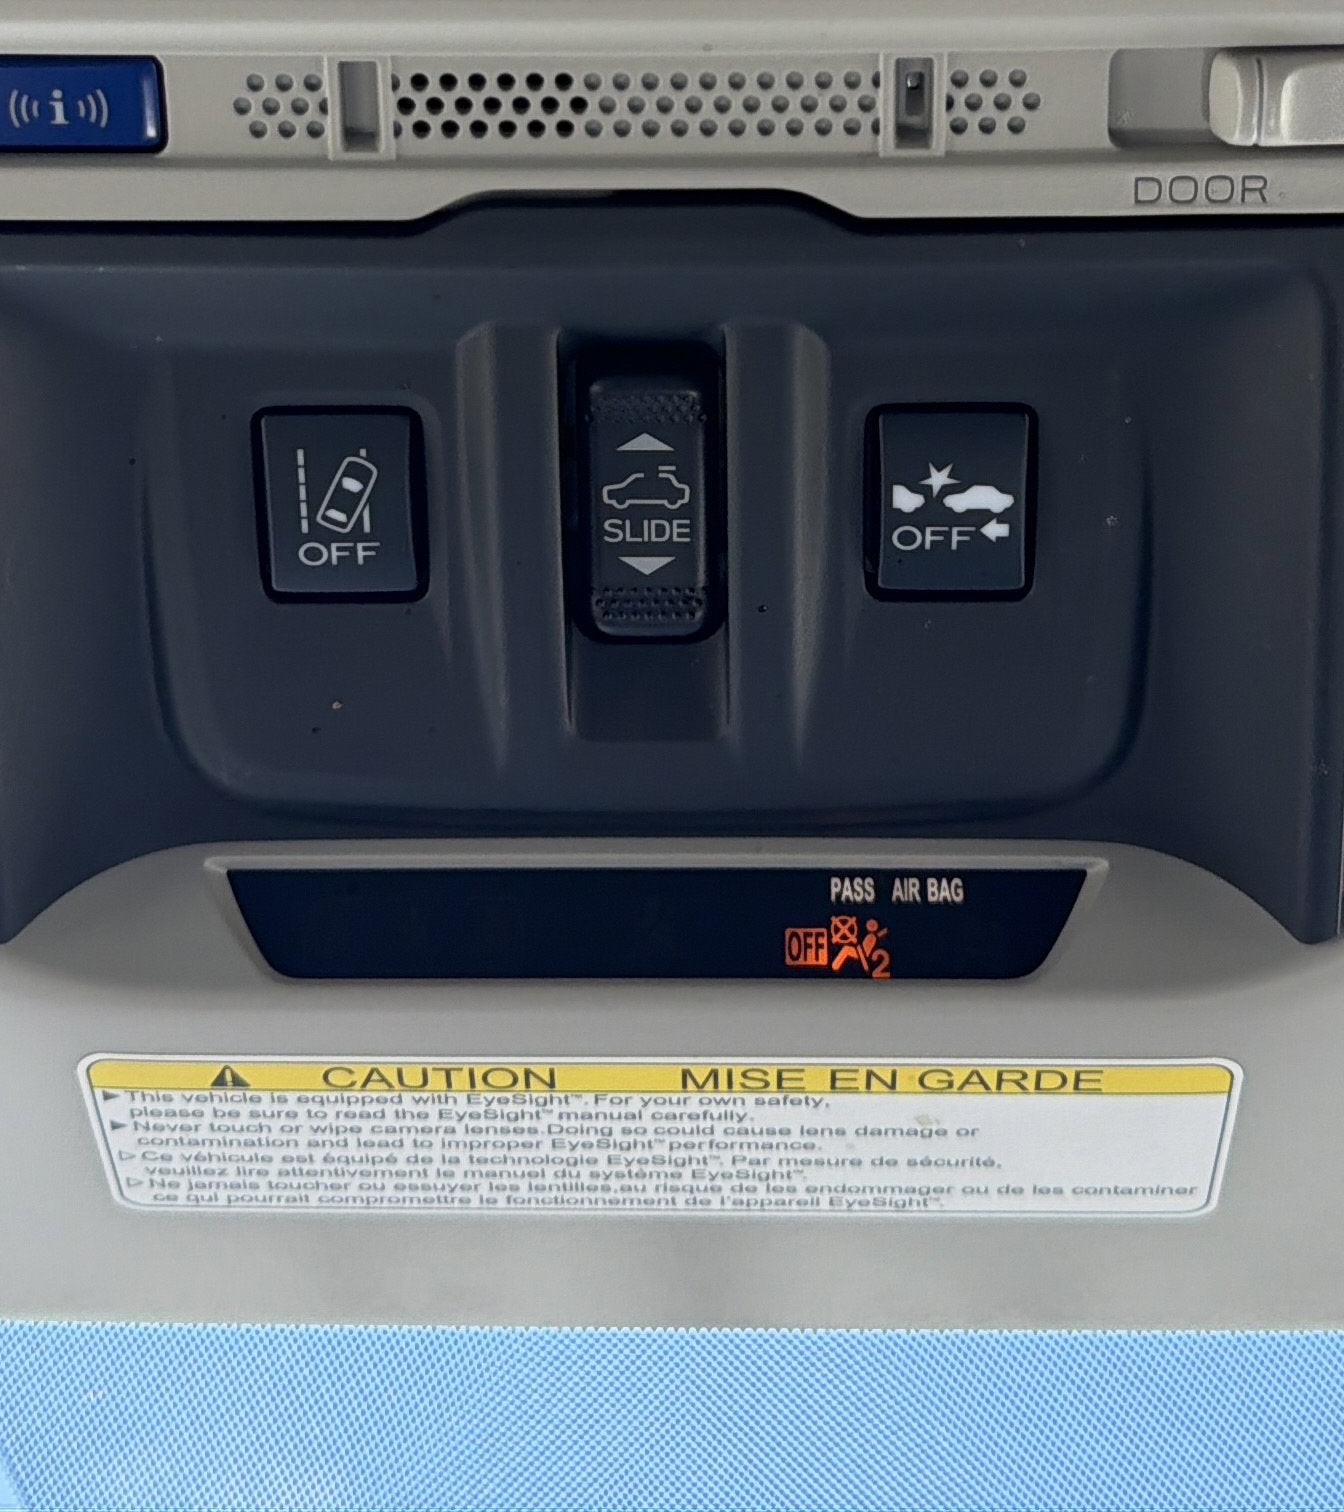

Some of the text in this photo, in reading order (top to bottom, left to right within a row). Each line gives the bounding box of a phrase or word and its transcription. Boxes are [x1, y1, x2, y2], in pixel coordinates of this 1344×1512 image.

[1133, 175, 1269, 205] DOOR
[603, 519, 691, 544] SLIDE
[891, 525, 976, 551] OFF
[299, 541, 380, 567] OFF
[830, 877, 964, 903] PASS AIR BAG
[787, 930, 825, 962] OFF
[871, 949, 890, 978] 2
[323, 1066, 556, 1089] CAUTION
[681, 1068, 1104, 1092] MISE EN GARDE
[125, 1090, 174, 1103] This
[181, 1091, 262, 1104] vehicle
[270, 1092, 288, 1104] is
[297, 1093, 403, 1107] equipped
[411, 1093, 458, 1105] with
[594, 1094, 633, 1106] For
[640, 1096, 689, 1108] your
[698, 1096, 746, 1106] own
[129, 1106, 205, 1119] please
[212, 1107, 241, 1118] be
[248, 1109, 298, 1119] sure
[306, 1109, 328, 1119] to
[335, 1109, 386, 1120] read
[394, 1109, 430, 1120] the
[558, 1110, 643, 1121] manual
[651, 1109, 754, 1123] carefully.
[133, 1120, 202, 1133] Never
[209, 1121, 272, 1133] touch
[280, 1124, 303, 1134] or
[309, 1123, 363, 1136] wipe
[370, 1124, 457, 1134] camera
[621, 1126, 647, 1135] so
[654, 1124, 715, 1136] could
[723, 1126, 792, 1136] cause
[800, 1125, 847, 1136] lens
[854, 1125, 949, 1138] damage
[956, 1127, 980, 1137] or
[137, 1135, 299, 1148] contamination
[307, 1137, 348, 1148] and
[357, 1137, 404, 1149] lead
[413, 1138, 434, 1149] to
[441, 1138, 543, 1151] improper
[669, 1138, 822, 1151] performance.
[141, 1150, 173, 1162] Ce
[181, 1151, 274, 1163] véhicule
[281, 1153, 314, 1163] est
[323, 1152, 398, 1166] équipé
[406, 1153, 434, 1165] de
[441, 1154, 461, 1165] la
[468, 1154, 598, 1167] technologie
[731, 1155, 770, 1166] Par
[778, 1157, 863, 1167] mesure
[870, 1156, 899, 1167] de
[144, 1166, 228, 1176] veuillez
[236, 1166, 270, 1177] lire
[278, 1166, 429, 1178] attentivement
[437, 1167, 455, 1178] le
[463, 1168, 546, 1179] manuel
[554, 1168, 581, 1179] du
[589, 1167, 683, 1180] système
[149, 1178, 181, 1189] Ne
[187, 1179, 260, 1191] jamais
[268, 1180, 351, 1191] toucher
[358, 1182, 386, 1191] ou
[393, 1182, 481, 1193] essuyer
[489, 1181, 521, 1192] les
[654, 1182, 723, 1194] risque
[730, 1182, 758, 1193] de
[766, 1183, 797, 1193] les
[805, 1183, 953, 1196] endommager
[961, 1185, 989, 1194] ou
[997, 1184, 1024, 1195] de
[1032, 1184, 1064, 1195] les
[1071, 1184, 1198, 1195] contaminer
[153, 1193, 179, 1202] ce
[186, 1192, 219, 1204] qui
[227, 1192, 309, 1204] pourrait
[317, 1194, 471, 1205] compromettre
[479, 1194, 499, 1205] le
[506, 1194, 677, 1206] fonctionnement
[684, 1195, 712, 1206] de
[720, 1195, 820, 1208] l'appareil
